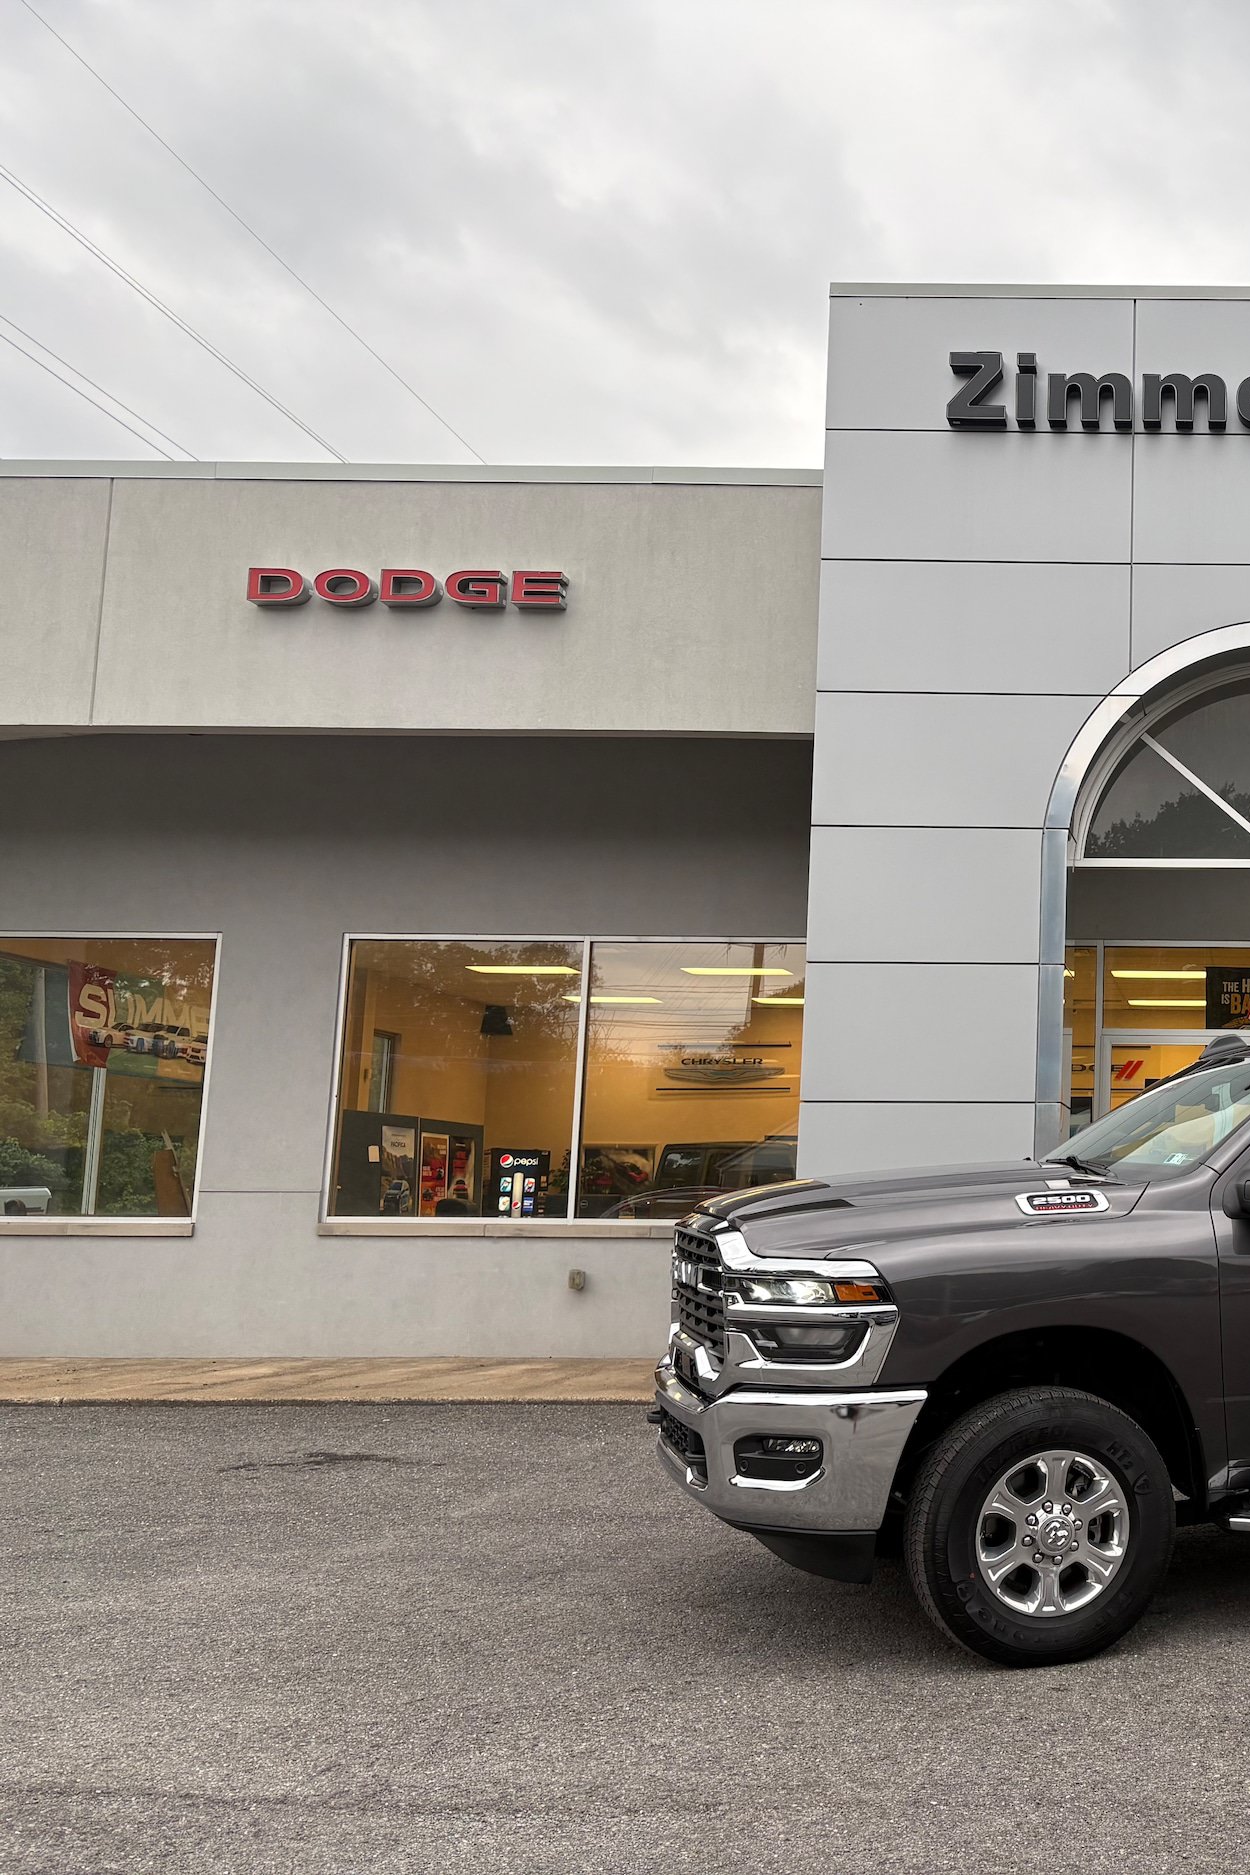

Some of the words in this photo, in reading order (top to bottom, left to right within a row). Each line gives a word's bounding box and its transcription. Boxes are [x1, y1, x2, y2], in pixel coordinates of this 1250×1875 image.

[247, 567, 569, 610] DODGE
[1222, 981, 1240, 993] THE
[1221, 993, 1231, 1005] IS
[681, 1057, 764, 1066] CHRYSLER
[513, 1157, 539, 1167] pepsi
[1032, 1195, 1091, 1205] 2500
